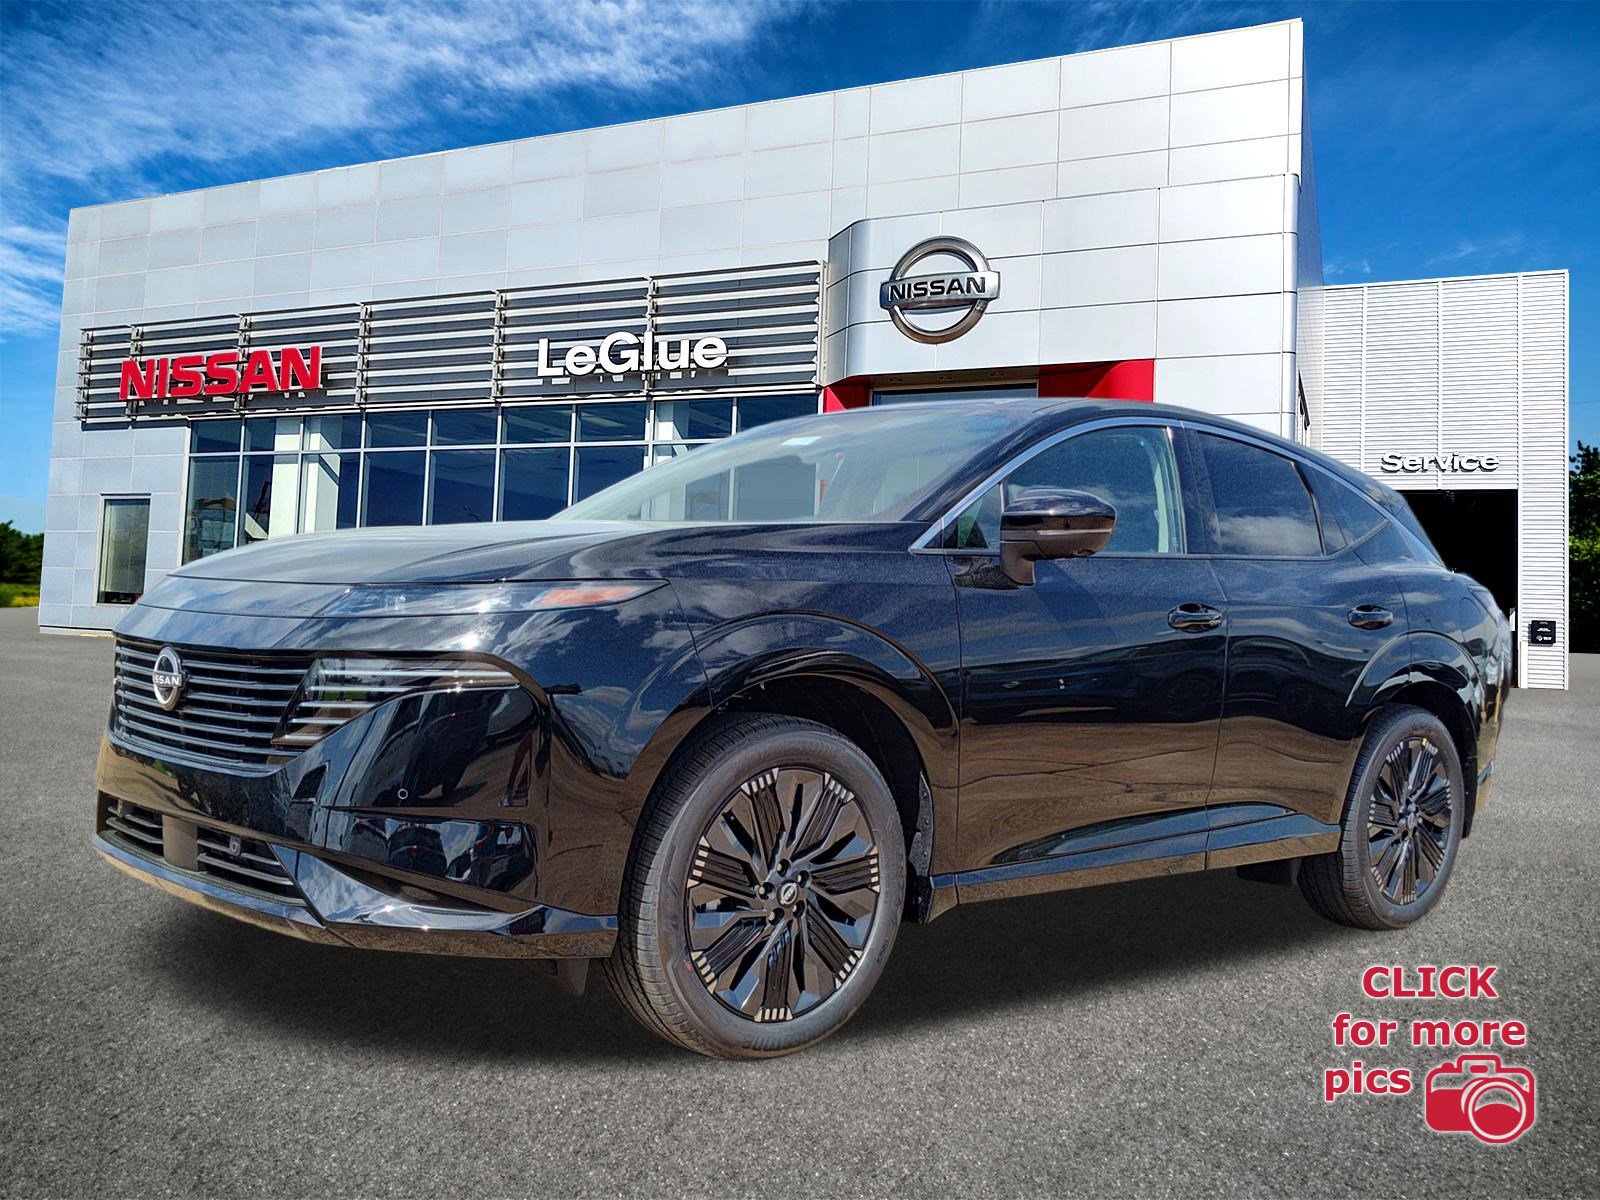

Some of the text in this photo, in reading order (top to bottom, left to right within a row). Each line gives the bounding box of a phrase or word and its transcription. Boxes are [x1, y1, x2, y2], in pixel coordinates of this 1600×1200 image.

[888, 276, 986, 301] NISSAN
[537, 331, 728, 377] LeGlue
[119, 346, 321, 400] NISSAN
[1381, 451, 1500, 473] Service
[154, 674, 180, 685] SSAN
